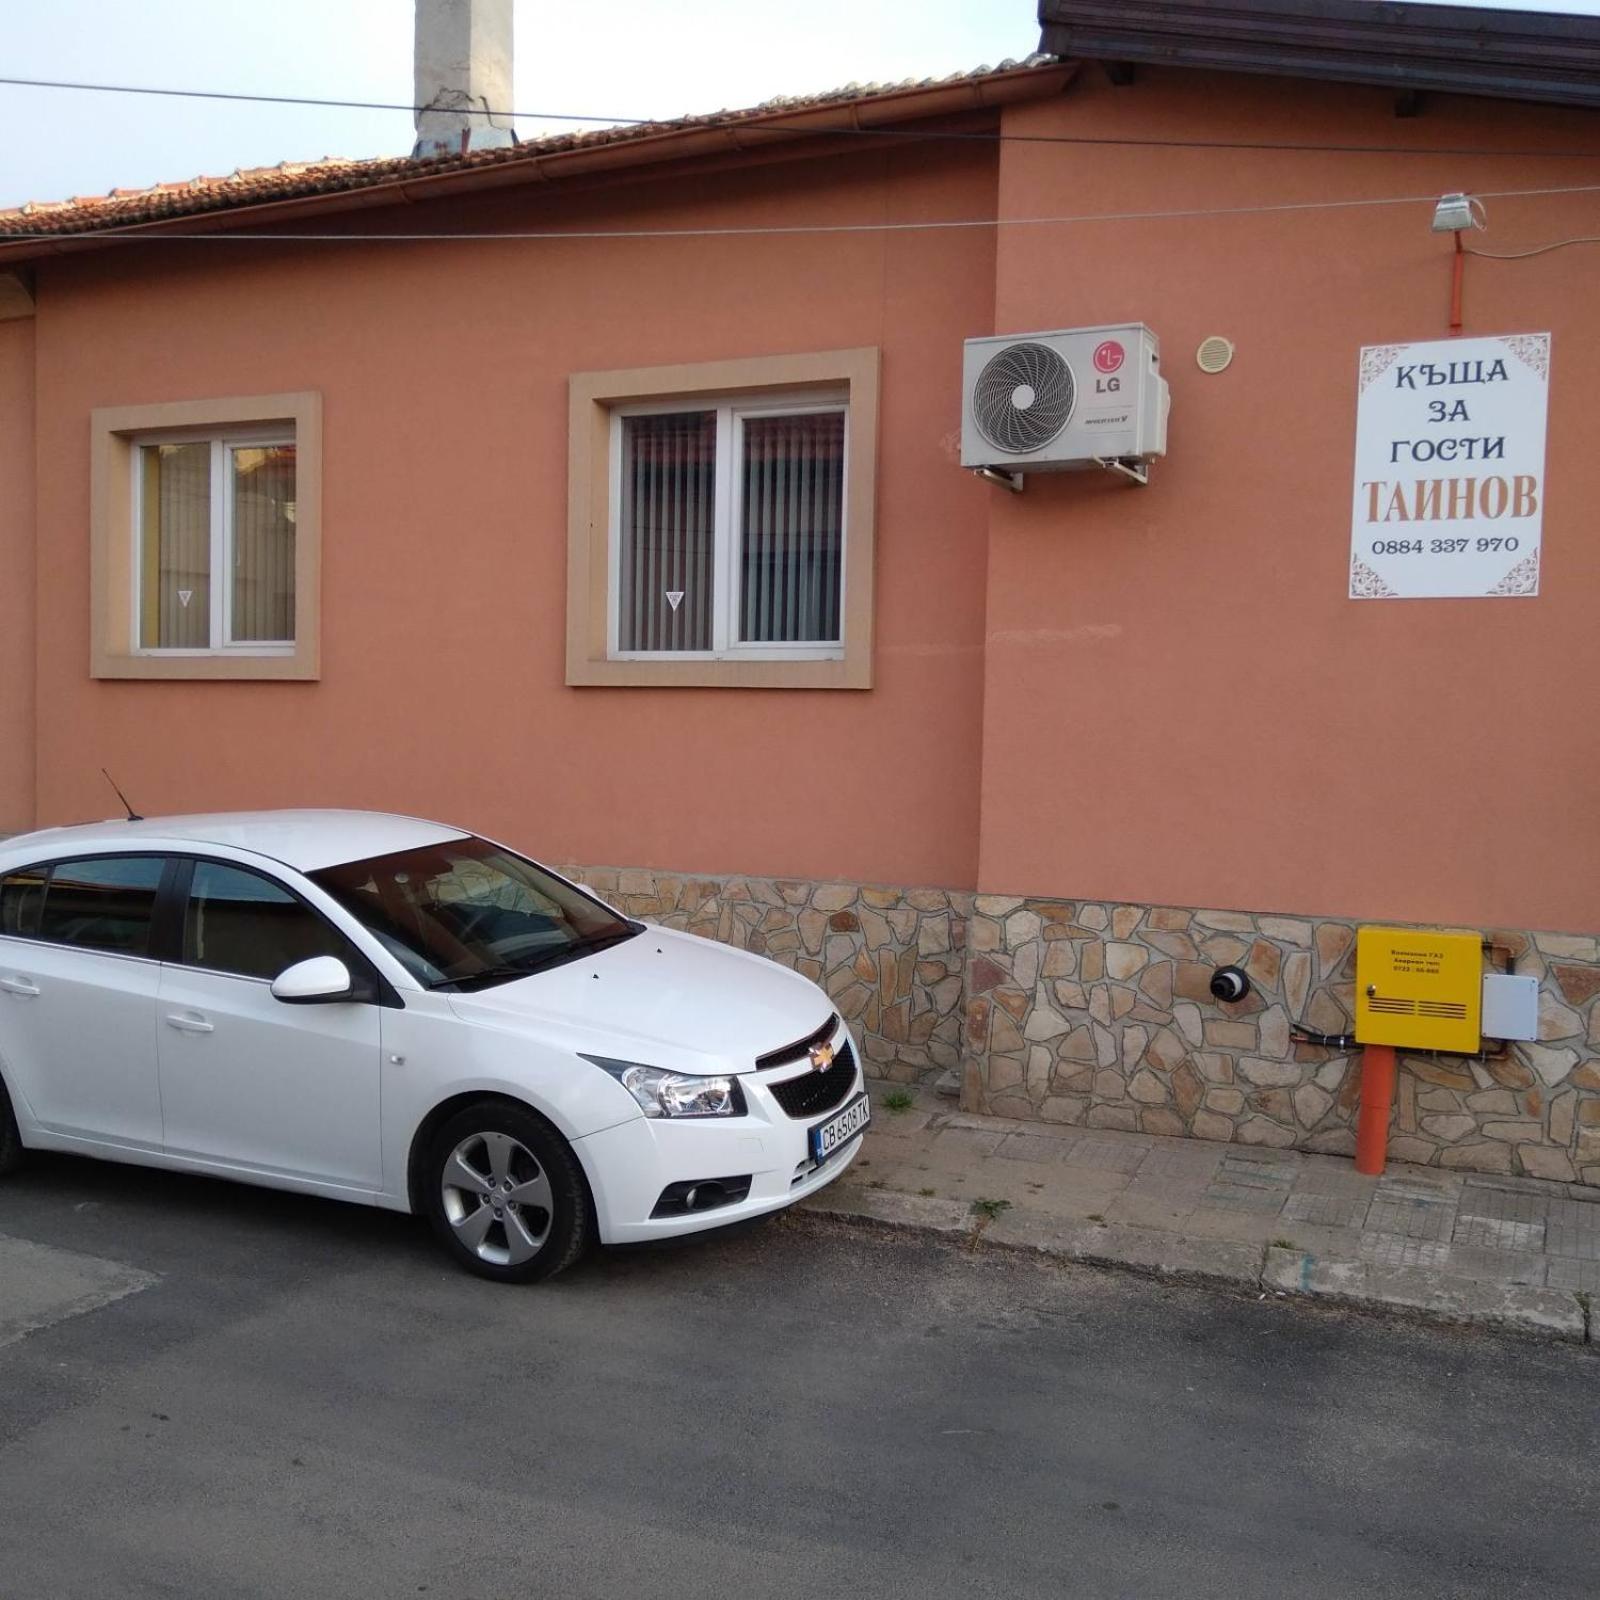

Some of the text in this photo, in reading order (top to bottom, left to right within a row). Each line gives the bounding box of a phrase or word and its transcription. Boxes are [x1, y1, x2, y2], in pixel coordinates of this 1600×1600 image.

[1096, 377, 1121, 393] LG
[1395, 359, 1509, 390] КЪЩА
[1428, 400, 1470, 423] ЗА
[1390, 437, 1505, 463] ГОСТИ
[1372, 537, 1519, 555] 0884 337 970
